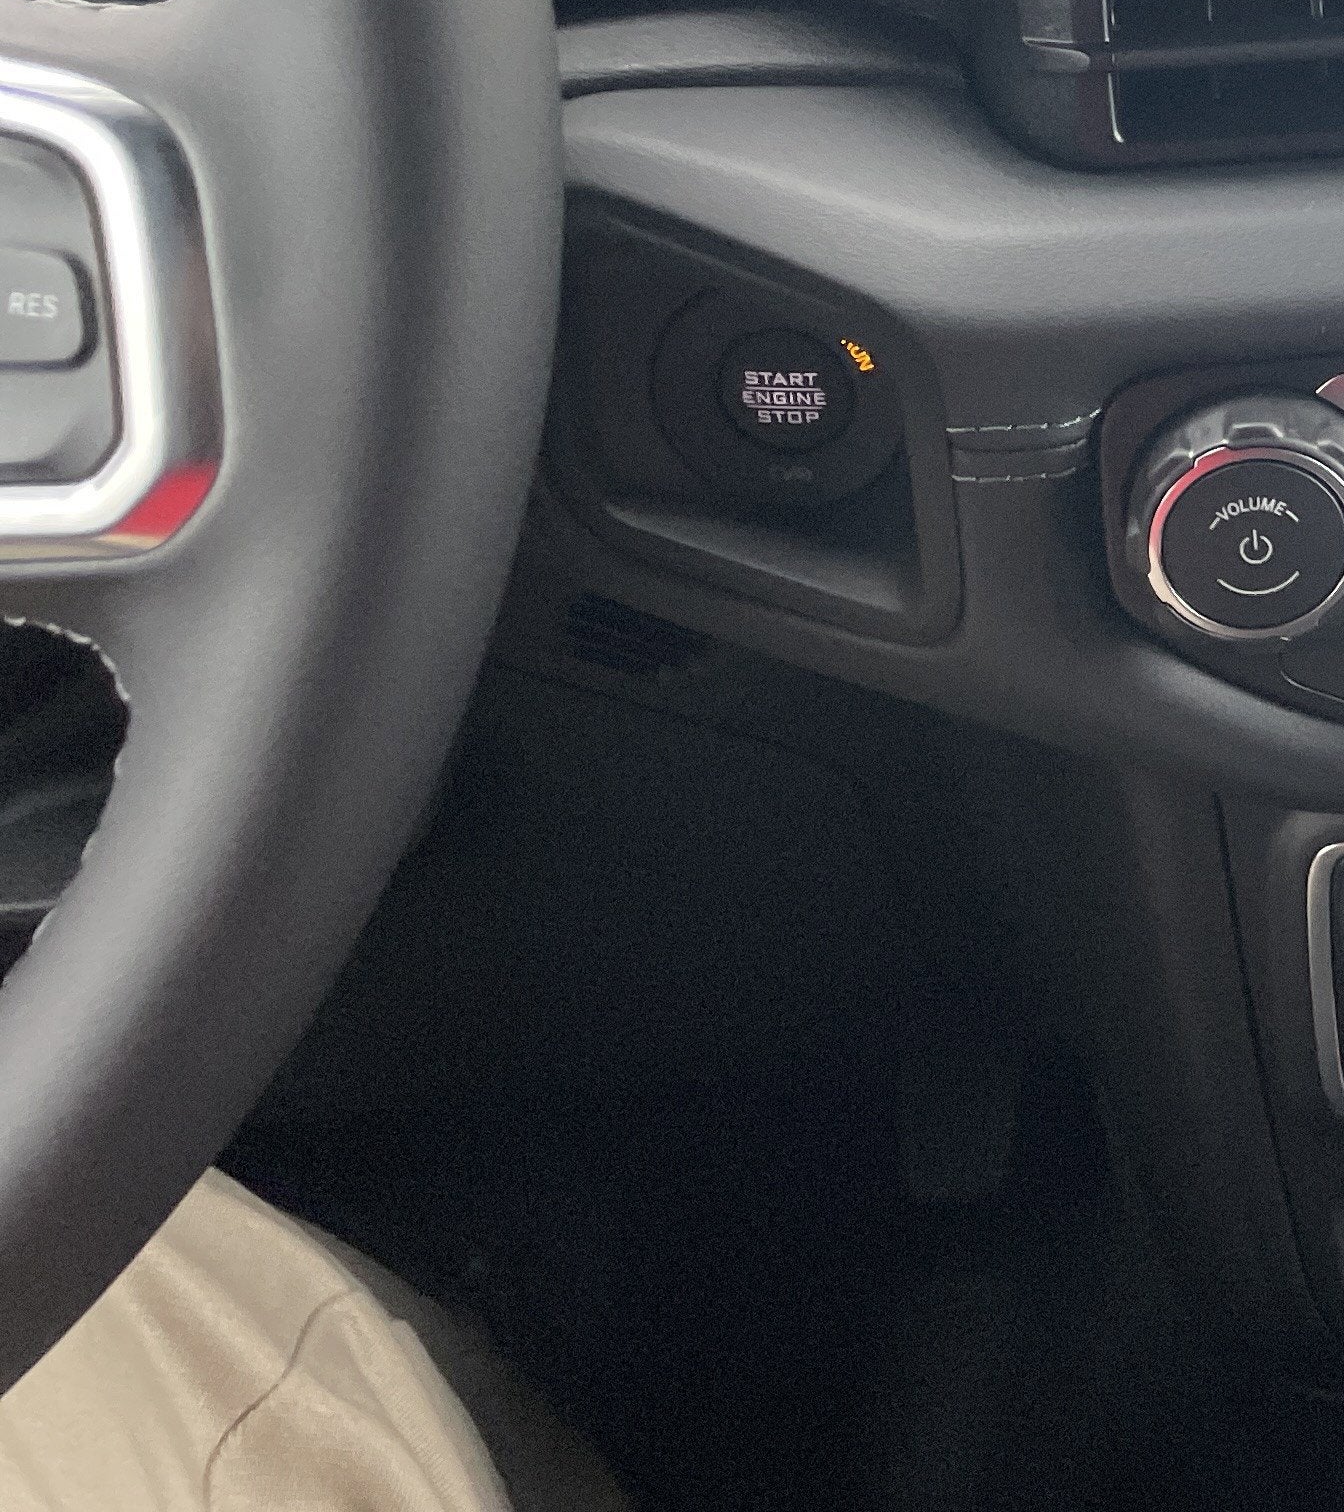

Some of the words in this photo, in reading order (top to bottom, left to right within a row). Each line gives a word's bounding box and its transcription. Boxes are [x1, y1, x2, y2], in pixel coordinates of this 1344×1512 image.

[8, 292, 59, 319] RES
[744, 371, 818, 387] START
[742, 390, 827, 406] ENGINE
[757, 410, 820, 424] STOP
[1217, 497, 1287, 522] VOLUME
